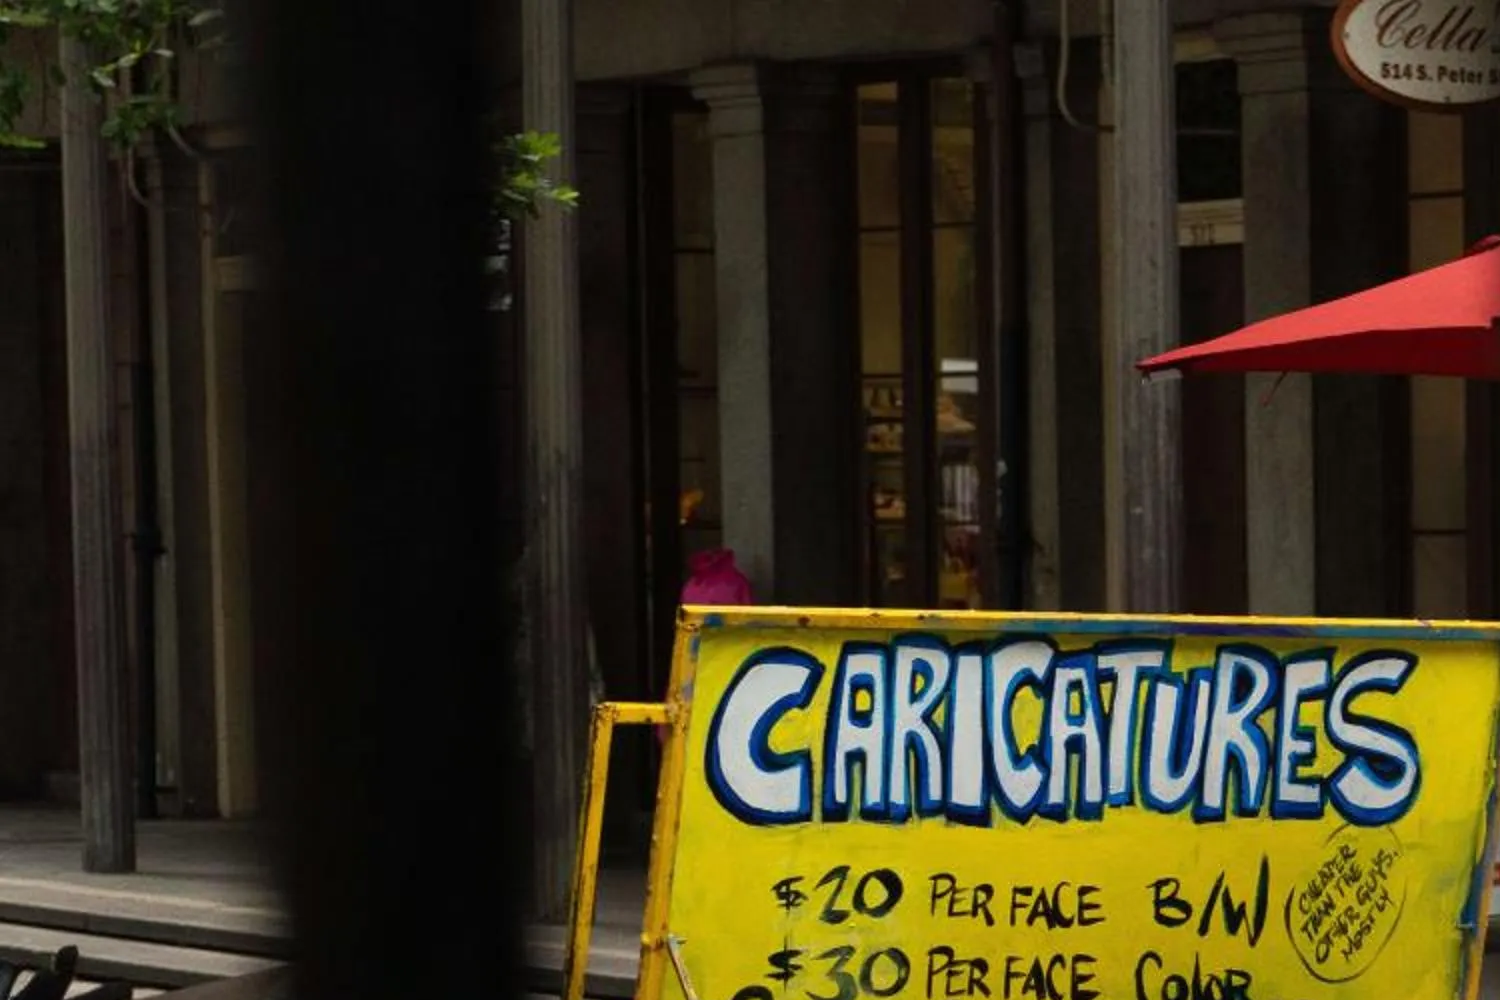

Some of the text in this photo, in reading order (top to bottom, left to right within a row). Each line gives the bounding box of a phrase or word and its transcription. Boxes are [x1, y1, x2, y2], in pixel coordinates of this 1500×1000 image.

[1381, 63, 1412, 80] 514
[1416, 64, 1433, 81] S.
[1438, 65, 1483, 84] Peter
[705, 633, 1421, 827] CARICATURES
[772, 853, 1270, 948] $20 PER FACE B/W
[927, 946, 992, 1000] PER
